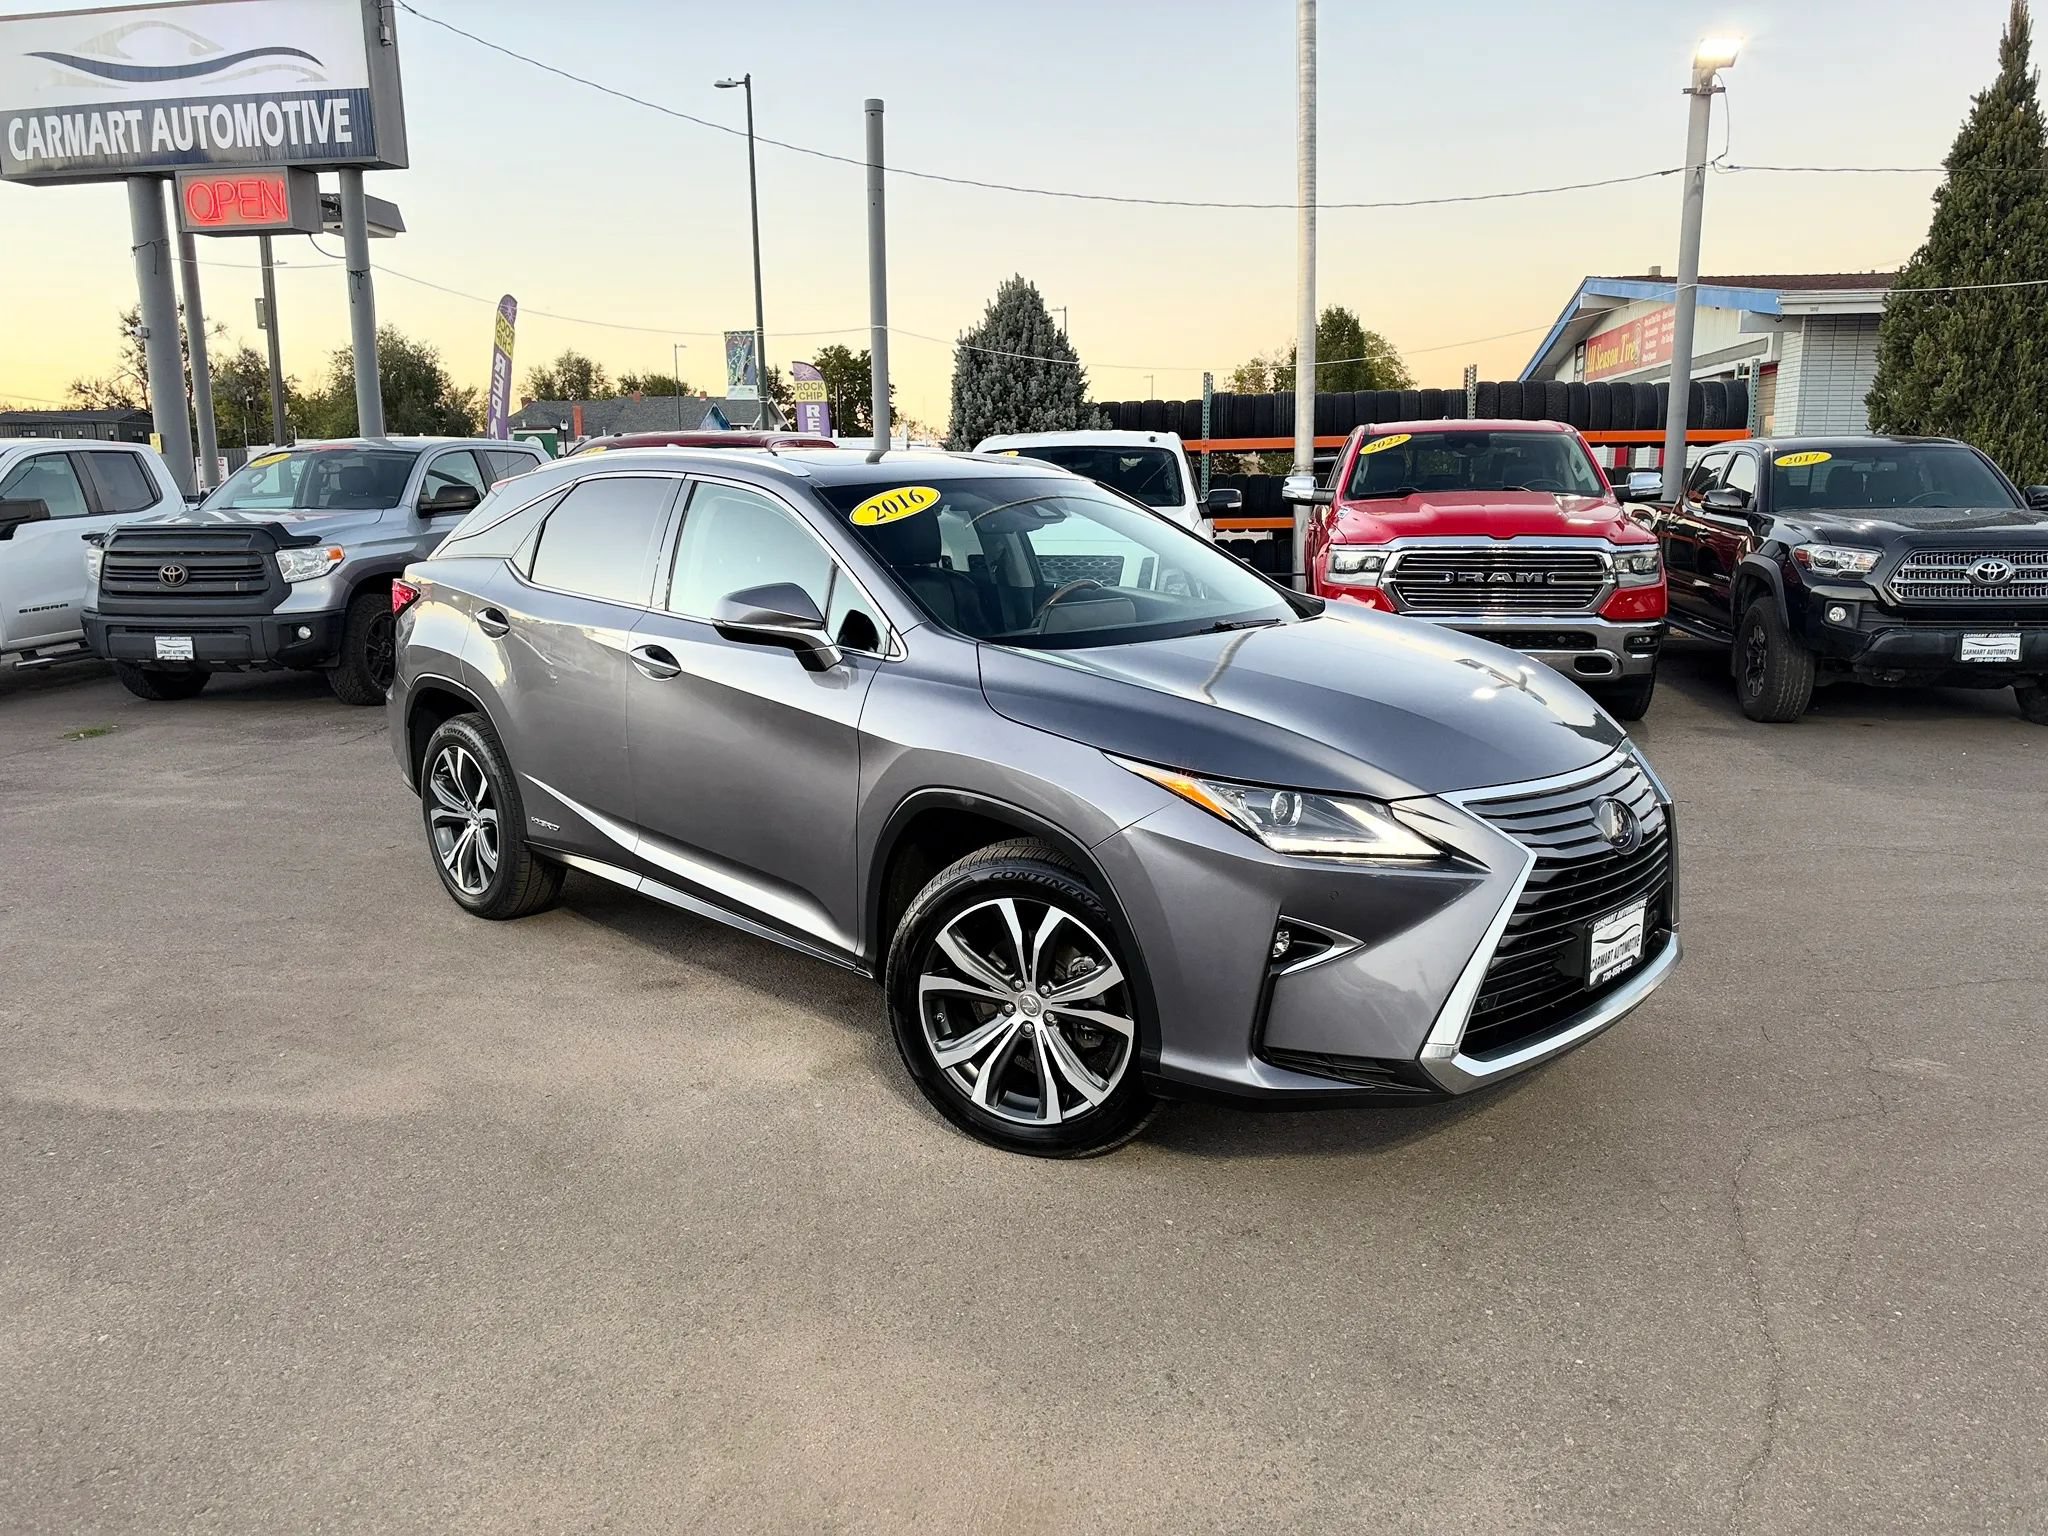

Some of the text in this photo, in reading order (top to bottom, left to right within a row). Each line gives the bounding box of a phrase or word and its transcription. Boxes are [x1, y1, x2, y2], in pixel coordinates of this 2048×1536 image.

[8, 98, 353, 161] CARMART AUTOMOTIVE
[187, 180, 287, 222] OPEN
[1596, 343, 1619, 371] Season
[796, 382, 825, 391] ROCK
[798, 391, 823, 401] CHIP
[805, 404, 821, 437] RE
[1370, 436, 1401, 451] 2022
[1785, 452, 1819, 465] 2017
[867, 489, 925, 521] 2016
[1457, 571, 1544, 583] RAM
[18, 603, 69, 614] SIERRA
[1962, 648, 2018, 656] CARMART AUTOMOTIVE
[1591, 948, 1614, 971] CARMART
[1614, 933, 1641, 959] AUTOMOTIVE
